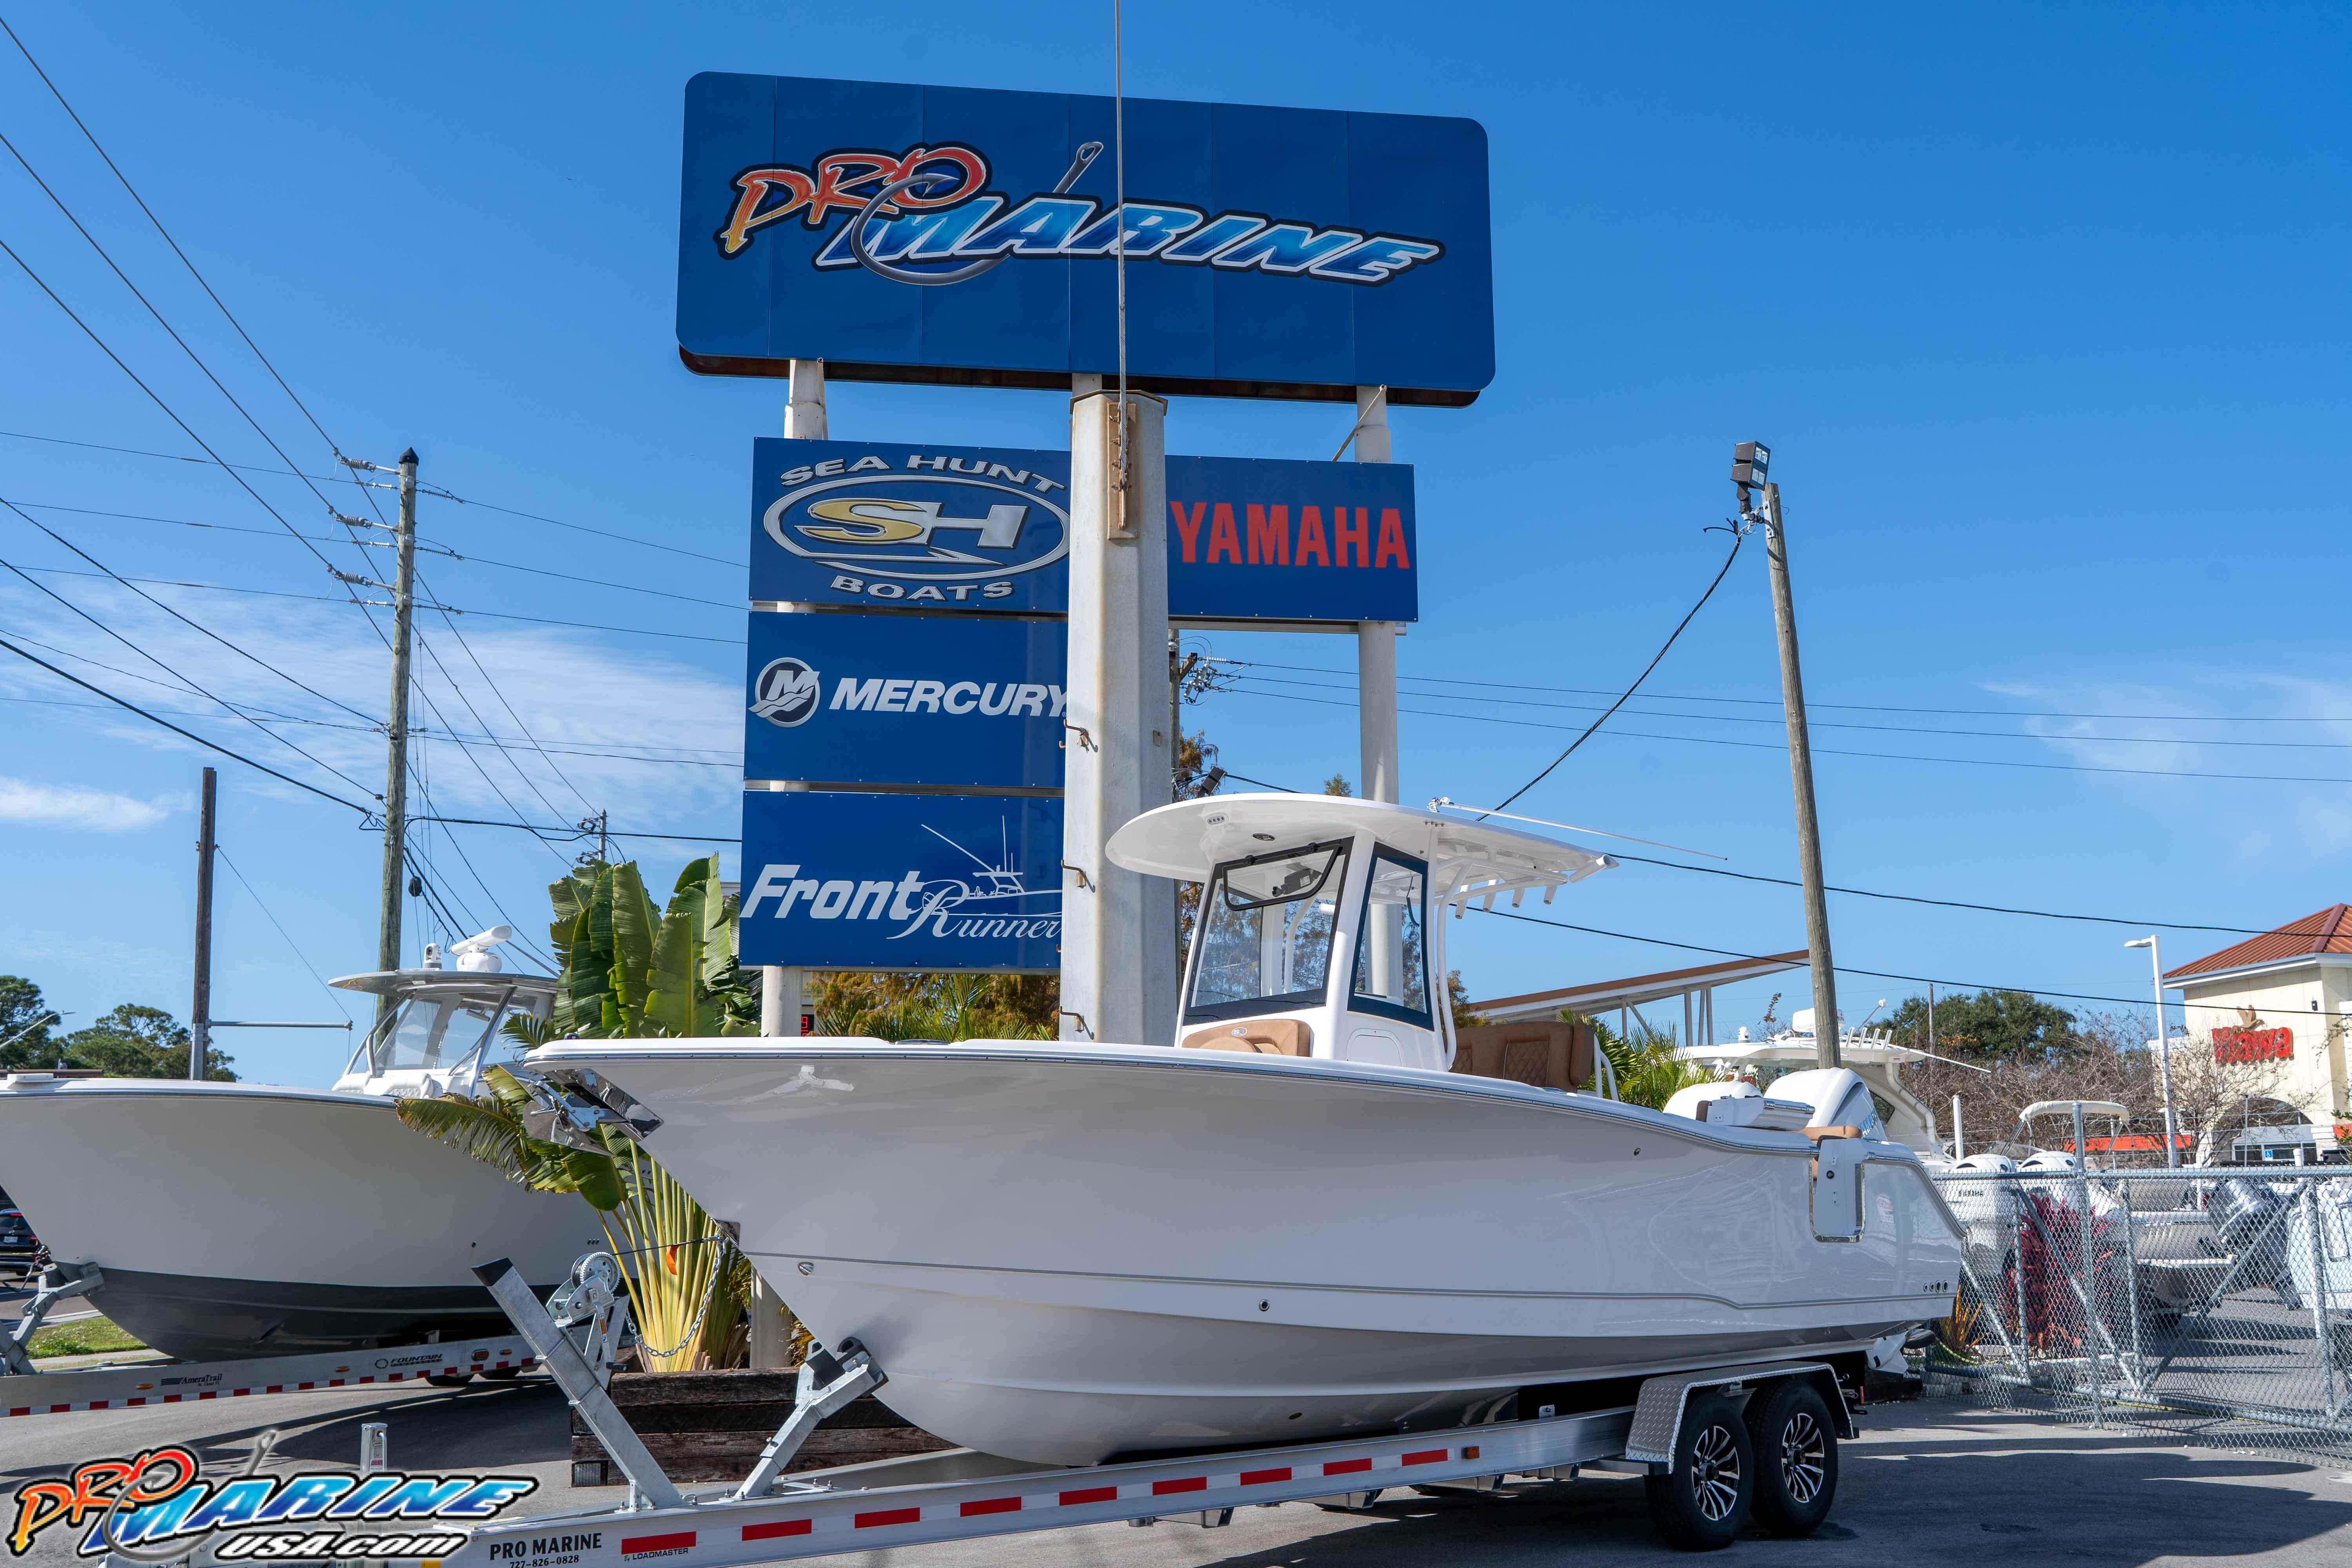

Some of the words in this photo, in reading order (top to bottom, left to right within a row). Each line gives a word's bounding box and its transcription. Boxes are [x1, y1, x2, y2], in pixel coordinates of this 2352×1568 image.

[720, 146, 986, 252] PRO
[815, 195, 1440, 282] MARINE
[780, 456, 893, 486] SEA
[906, 455, 1067, 493] HUNT
[1169, 501, 1410, 569] YAMAHA
[829, 575, 1015, 601] BOATS
[829, 677, 1067, 717] MERCURY
[739, 864, 925, 920] Front
[886, 878, 1062, 940] Runner
[391, 1354, 443, 1363] FOUNTAIN
[181, 1373, 223, 1385] AmeraTrail
[489, 1540, 527, 1561] PRO
[532, 1532, 603, 1556] MARINE
[510, 1554, 579, 1568] 727-826-0828
[632, 1548, 689, 1560] LOADMASTER
